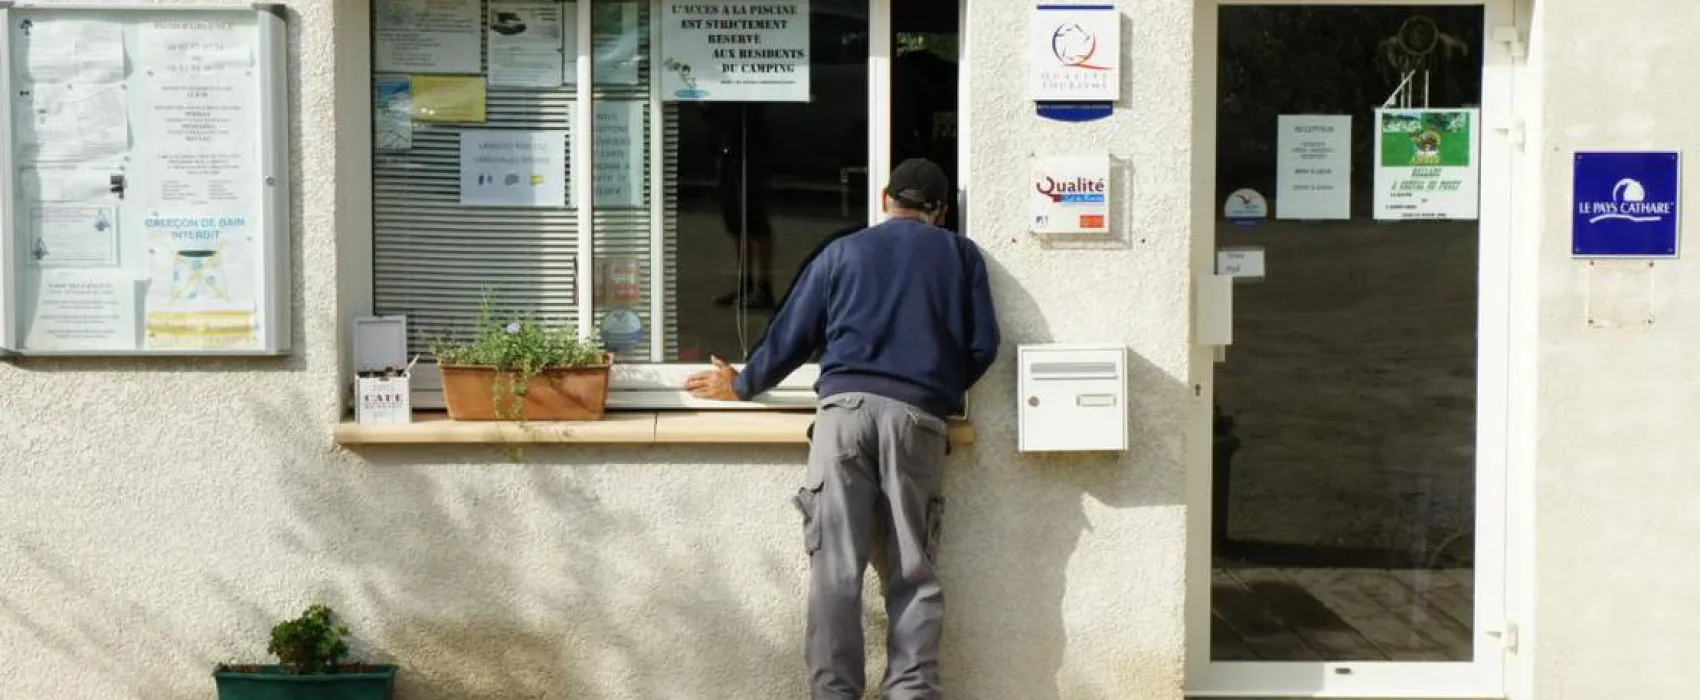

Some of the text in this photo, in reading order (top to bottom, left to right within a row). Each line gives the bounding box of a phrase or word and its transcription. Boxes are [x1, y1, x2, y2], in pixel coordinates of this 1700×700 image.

[750, 4, 797, 15] PISCINE
[681, 19, 788, 30] EST STRICTEMENT
[708, 34, 762, 44] RESERVE
[712, 48, 805, 59] AUX RESIDENTS
[722, 63, 796, 74] DU CAMPING
[1036, 176, 1105, 196] Qualité
[1579, 202, 1670, 214] LE PAYS CATHARE
